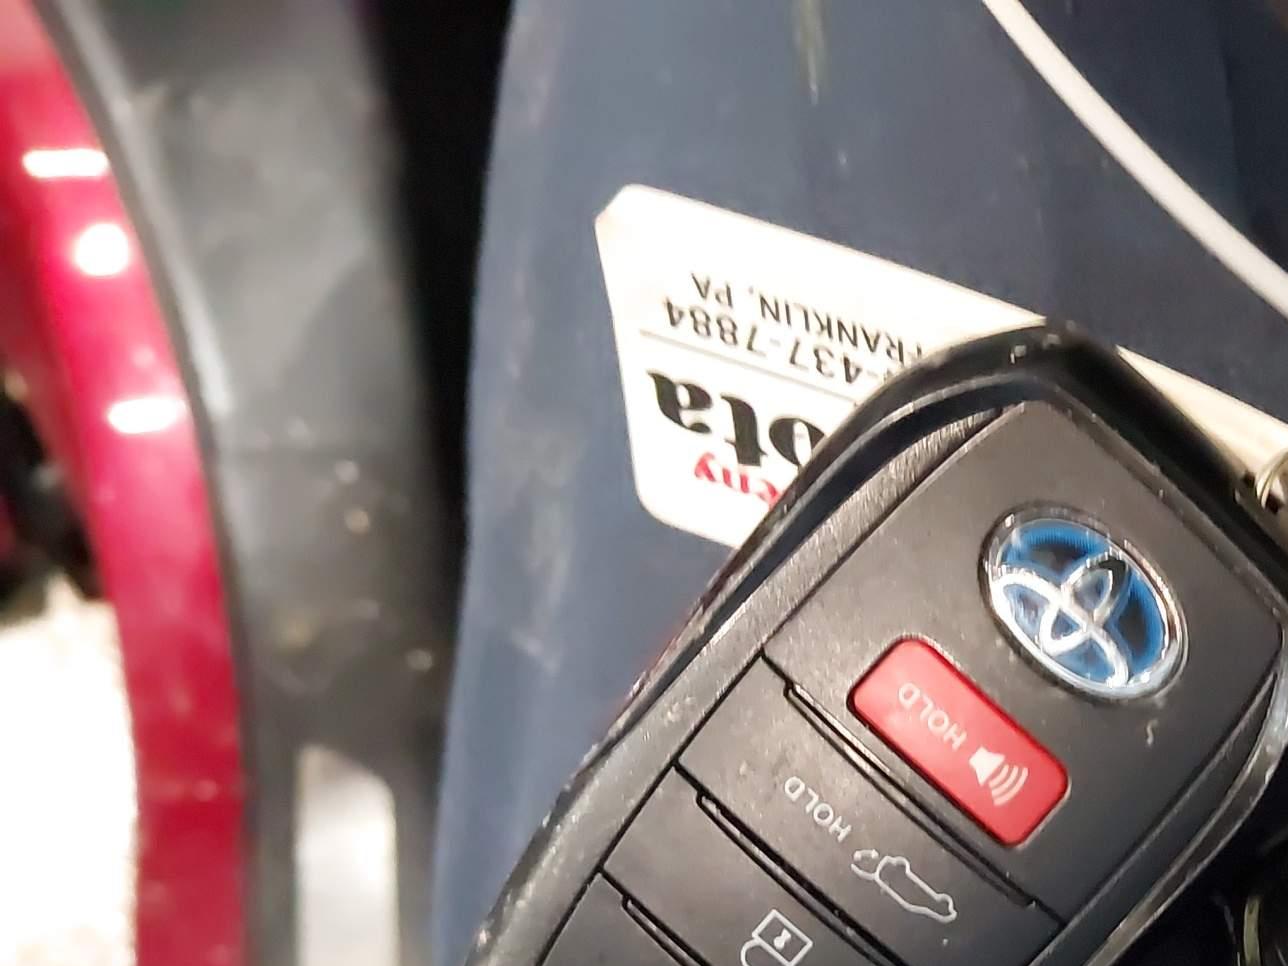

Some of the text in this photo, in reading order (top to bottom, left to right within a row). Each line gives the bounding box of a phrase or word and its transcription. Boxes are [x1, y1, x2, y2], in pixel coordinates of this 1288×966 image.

[690, 272, 734, 308] PA
[647, 370, 825, 467] ota
[694, 452, 782, 510] eny
[899, 682, 967, 751] HOLD
[784, 776, 851, 842] HOLD
